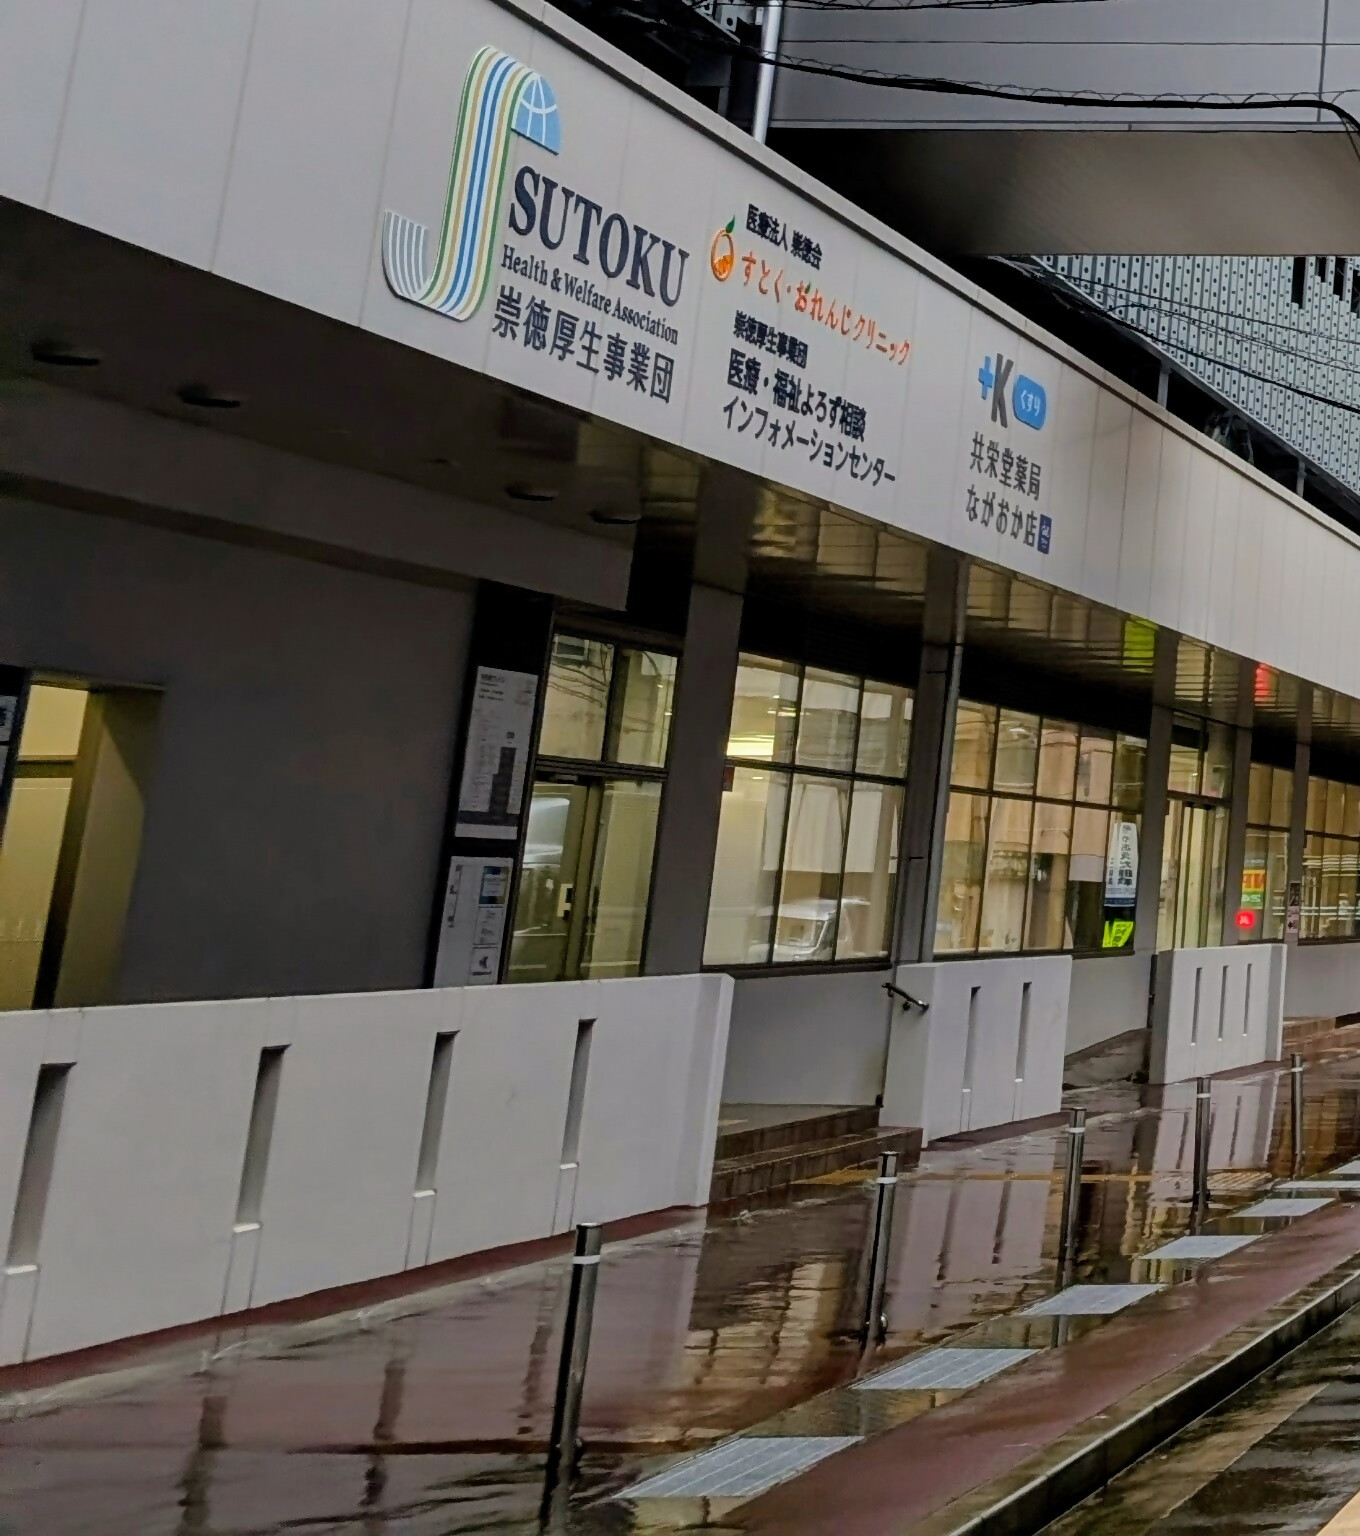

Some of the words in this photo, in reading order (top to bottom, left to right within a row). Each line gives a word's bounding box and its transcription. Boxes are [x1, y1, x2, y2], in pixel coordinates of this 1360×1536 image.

[508, 165, 690, 307] SUTOKU
[746, 203, 788, 252] 医療法人
[501, 244, 548, 286] Health
[550, 268, 562, 292] &
[564, 272, 611, 314] Welfare
[612, 297, 679, 345] Association
[733, 310, 808, 369] 崇徳厚生事業団
[741, 251, 910, 366] すとく・おれんじクリニック
[492, 284, 675, 404] 崇徳厚生事業団
[723, 395, 896, 487] インフォメーションセンター
[727, 348, 867, 443] 医療・福祉よろず相談
[1020, 389, 1041, 417] くすり
[970, 431, 1042, 501] 共栄堂薬局
[966, 484, 1038, 547] ながおか店
